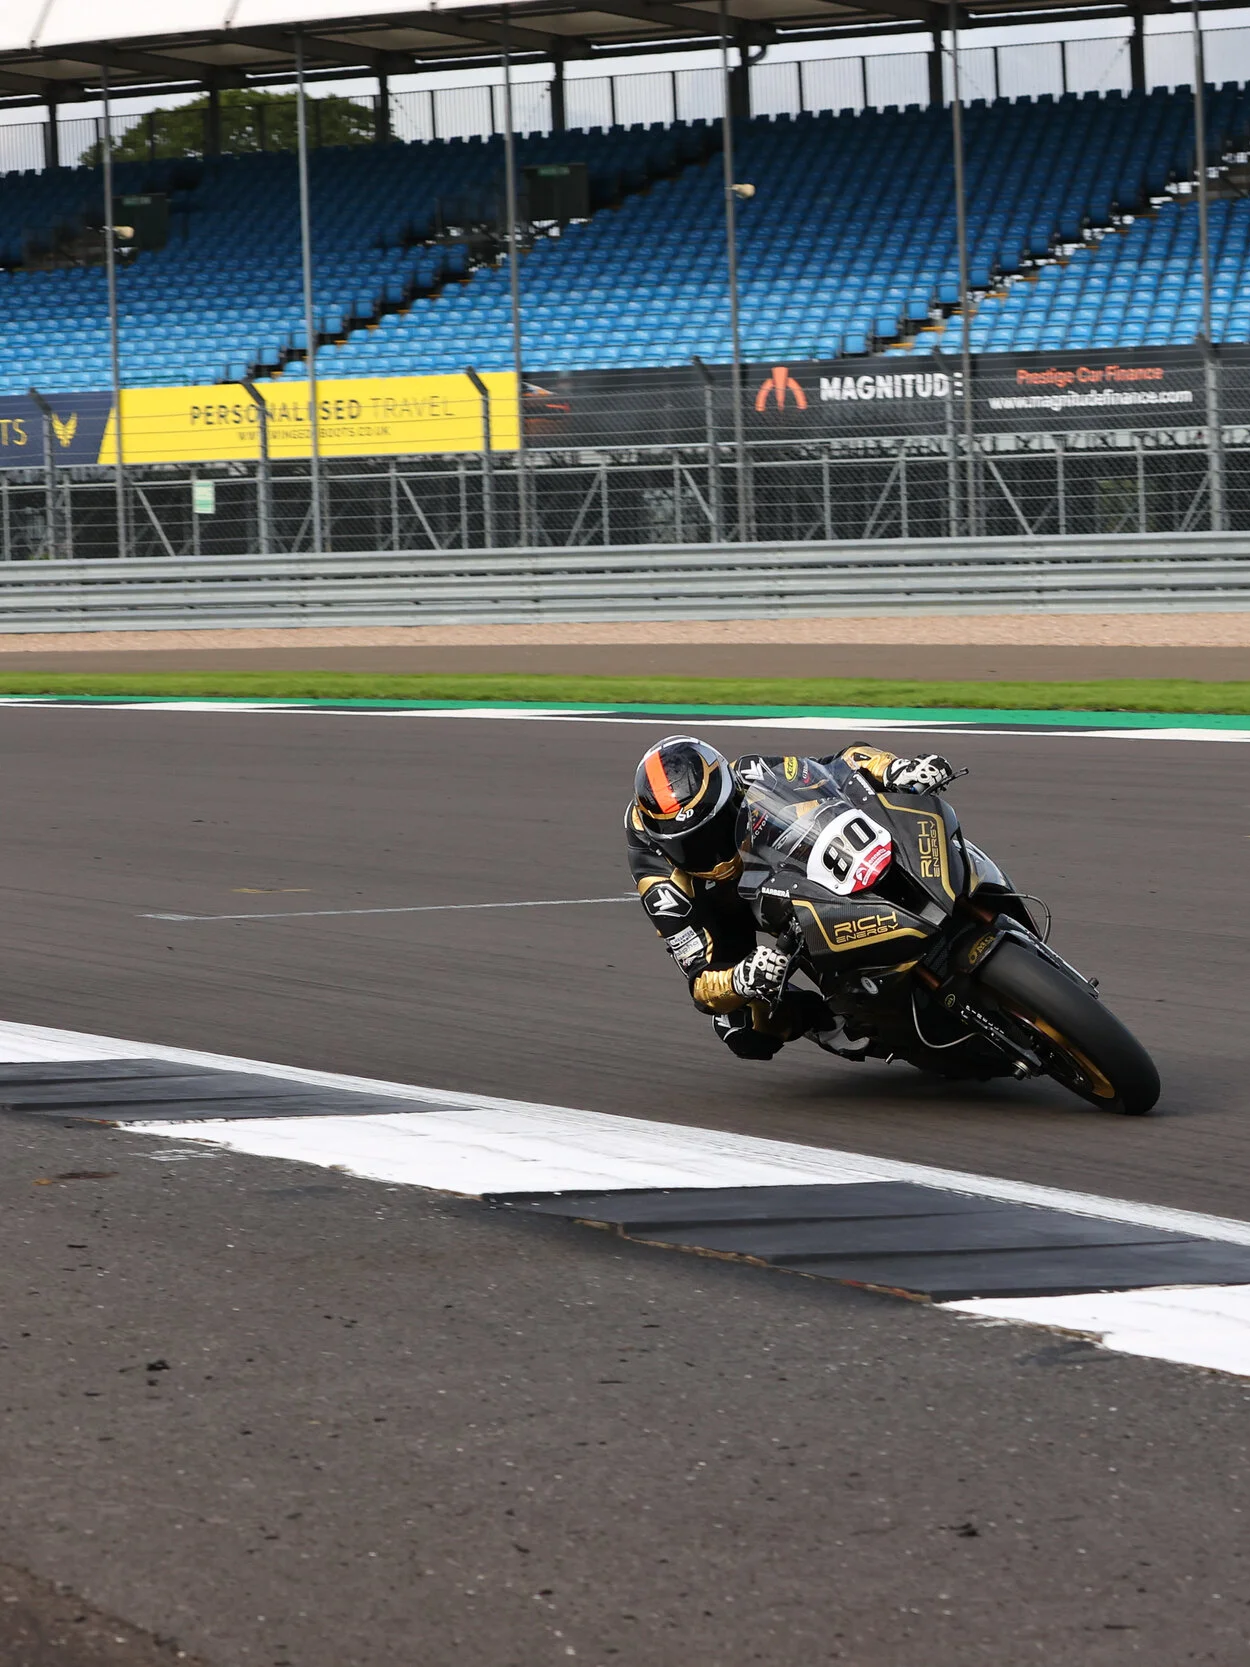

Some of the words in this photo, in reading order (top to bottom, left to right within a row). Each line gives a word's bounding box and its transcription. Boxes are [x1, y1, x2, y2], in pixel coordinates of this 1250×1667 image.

[819, 372, 964, 402] MAGNITUDE
[1016, 368, 1075, 388] Prestige
[1077, 366, 1103, 383] Car
[1105, 364, 1164, 382] Finance
[190, 399, 361, 426] PERSONALSED
[370, 395, 455, 420] TRAVEL
[988, 388, 1194, 412] www.magnitudefinance.com
[822, 816, 877, 883] 80
[917, 820, 934, 878] RICH
[929, 820, 941, 878] ENERGY
[833, 911, 897, 937] RICH
[836, 922, 899, 944] ENERGY
